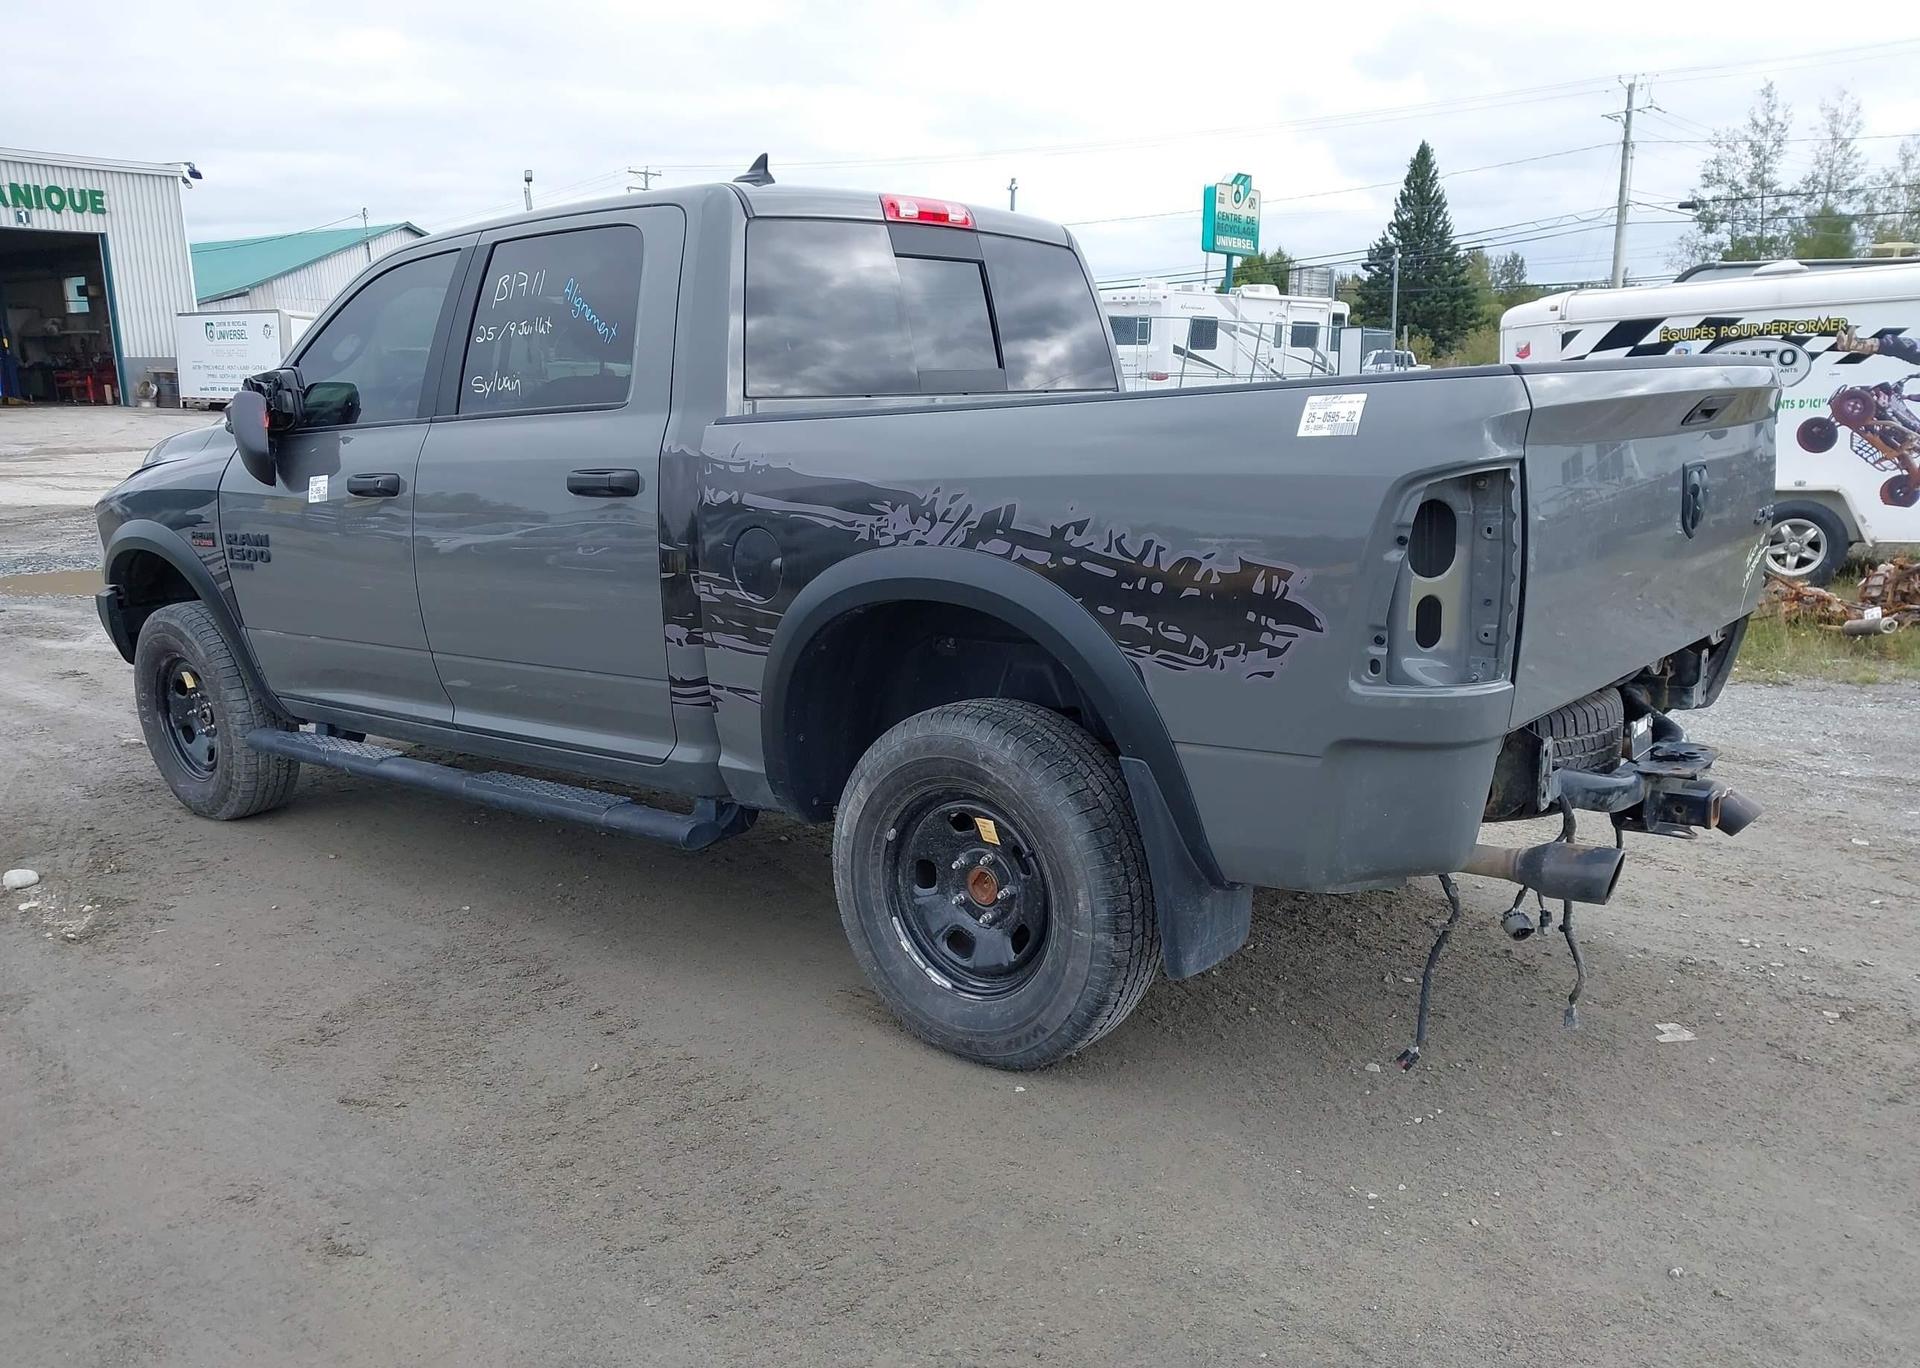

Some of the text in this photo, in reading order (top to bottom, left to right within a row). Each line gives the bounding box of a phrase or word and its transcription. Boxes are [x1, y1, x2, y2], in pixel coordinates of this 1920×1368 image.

[19, 211, 27, 224] 1
[1217, 211, 1256, 226] CENTRE DE
[1216, 222, 1256, 236] RECYCLAGE
[1216, 234, 1256, 250] UNIVERSEL
[1720, 323, 1760, 338] POUR
[1763, 316, 1848, 336] PERFORMER
[216, 329, 248, 341] UNIVERSEL
[471, 370, 521, 399] Sylvain
[225, 533, 270, 548] RAM
[229, 547, 272, 563] 1500
